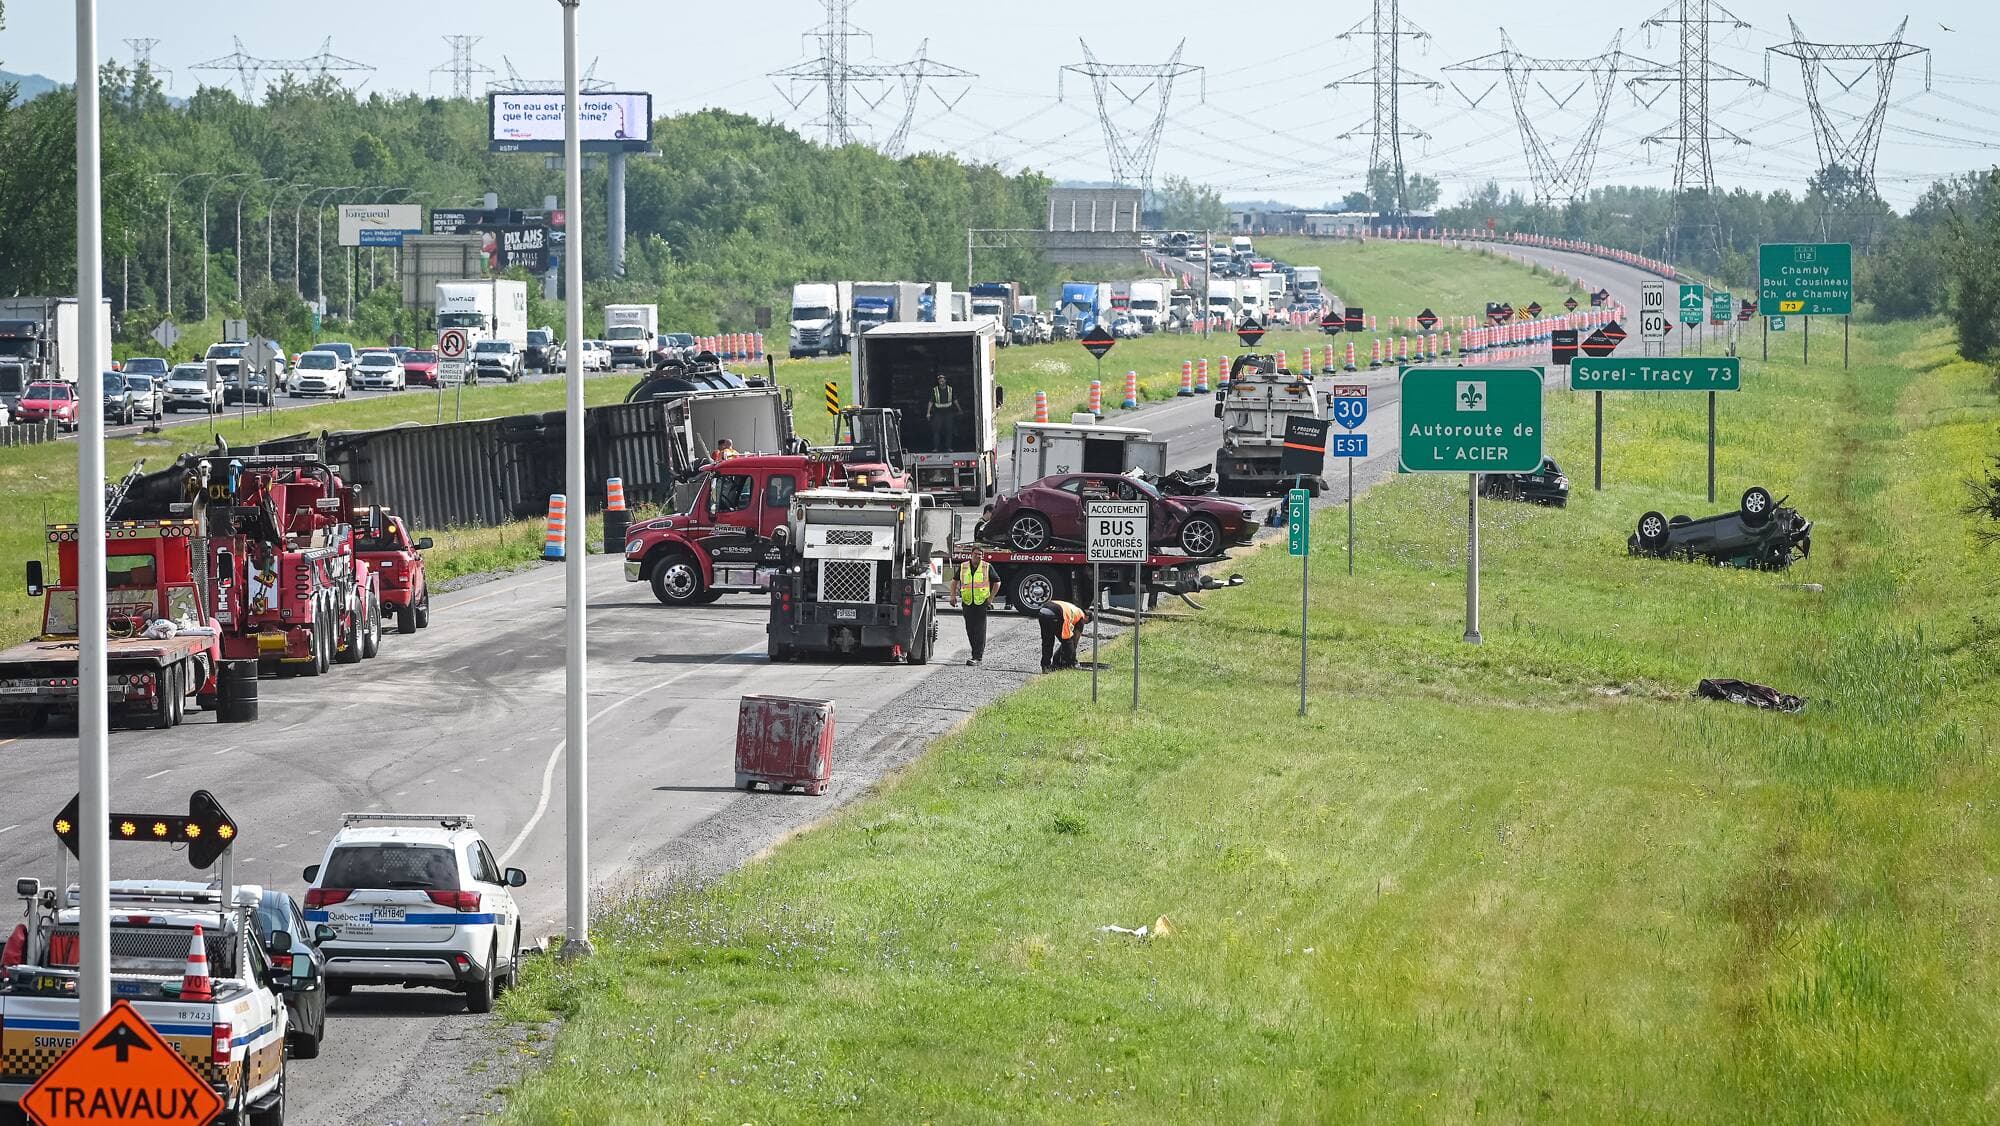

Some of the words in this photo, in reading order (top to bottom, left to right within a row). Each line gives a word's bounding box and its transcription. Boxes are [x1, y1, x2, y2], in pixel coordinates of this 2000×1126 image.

[503, 102, 520, 110] Ton
[584, 102, 612, 111] froide
[503, 114, 521, 122] que
[524, 112, 532, 120] le
[536, 112, 561, 120] canal
[505, 232, 520, 244] DIX
[523, 229, 543, 243] ANS
[1782, 266, 1829, 275] Chambly
[1644, 292, 1662, 306] 100
[1803, 290, 1848, 299] Chambly
[1646, 317, 1661, 331] 60
[1579, 367, 1693, 384] Sorel-Tracy
[1708, 368, 1732, 381] 73
[1339, 401, 1363, 417] 30
[1409, 424, 1503, 436] Autoroute
[1513, 423, 1533, 436] de
[1338, 440, 1363, 451] EST
[1434, 447, 1508, 460] L'ACIER
[1101, 521, 1134, 535] BUS
[1092, 537, 1142, 547] AUTORISÉS
[1091, 550, 1144, 558] SEULEMENT
[329, 912, 358, 922] Québec
[189, 1012, 211, 1020] 7423
[45, 1088, 199, 1119] TRAVAUX
